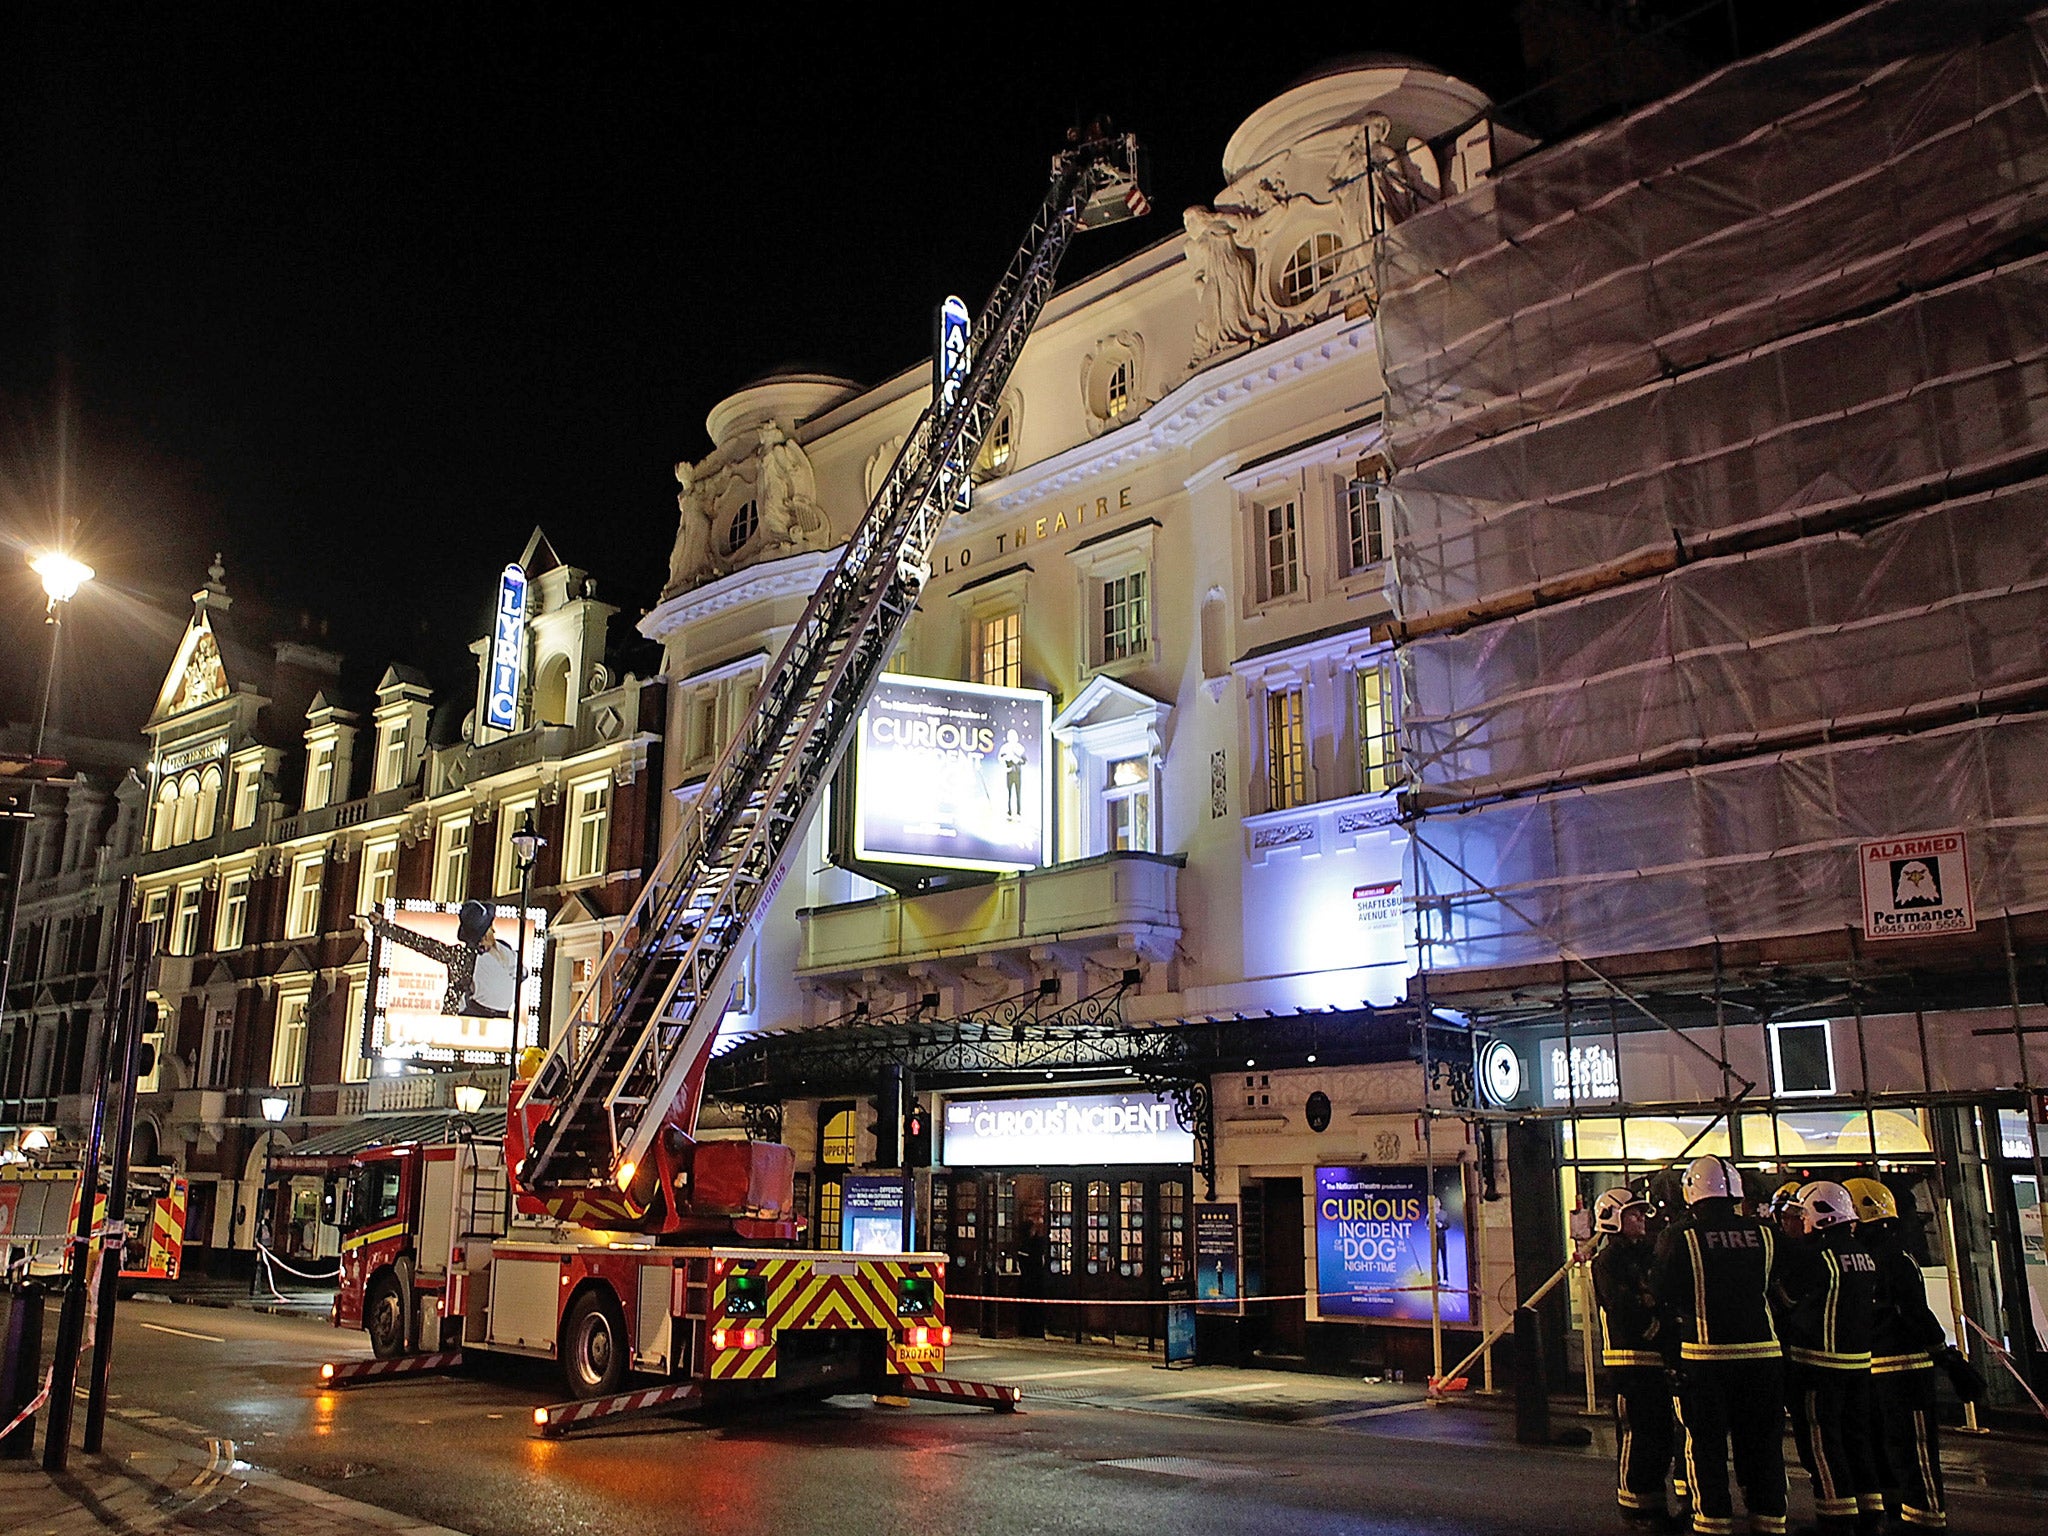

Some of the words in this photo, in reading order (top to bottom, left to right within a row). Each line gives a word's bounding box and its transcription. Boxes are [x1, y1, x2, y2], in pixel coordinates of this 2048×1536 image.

[996, 486, 1132, 553] THEATRE
[492, 588, 522, 719] LYRIC
[872, 716, 994, 754] CURIOUS
[1869, 838, 1957, 859] ALARMED
[755, 863, 786, 923] MAGIRUS
[1357, 897, 1402, 911] SHAFTESBU
[1358, 909, 1388, 921] AVENUE
[1874, 907, 1964, 925] Permanex
[1873, 924, 1905, 934] 0845
[1908, 922, 1932, 931] 069
[1936, 919, 1966, 930] 5555
[390, 996, 432, 1010] JACKSON
[974, 1109, 1064, 1136] CURIOUS
[1066, 1103, 1170, 1134] INCIDENT
[1322, 1199, 1420, 1221] CURIOUS
[1339, 1221, 1412, 1239] INCIDENT
[1705, 1230, 1760, 1249] FIRE
[1344, 1238, 1397, 1261] DOG
[900, 1348, 922, 1360] BX07
